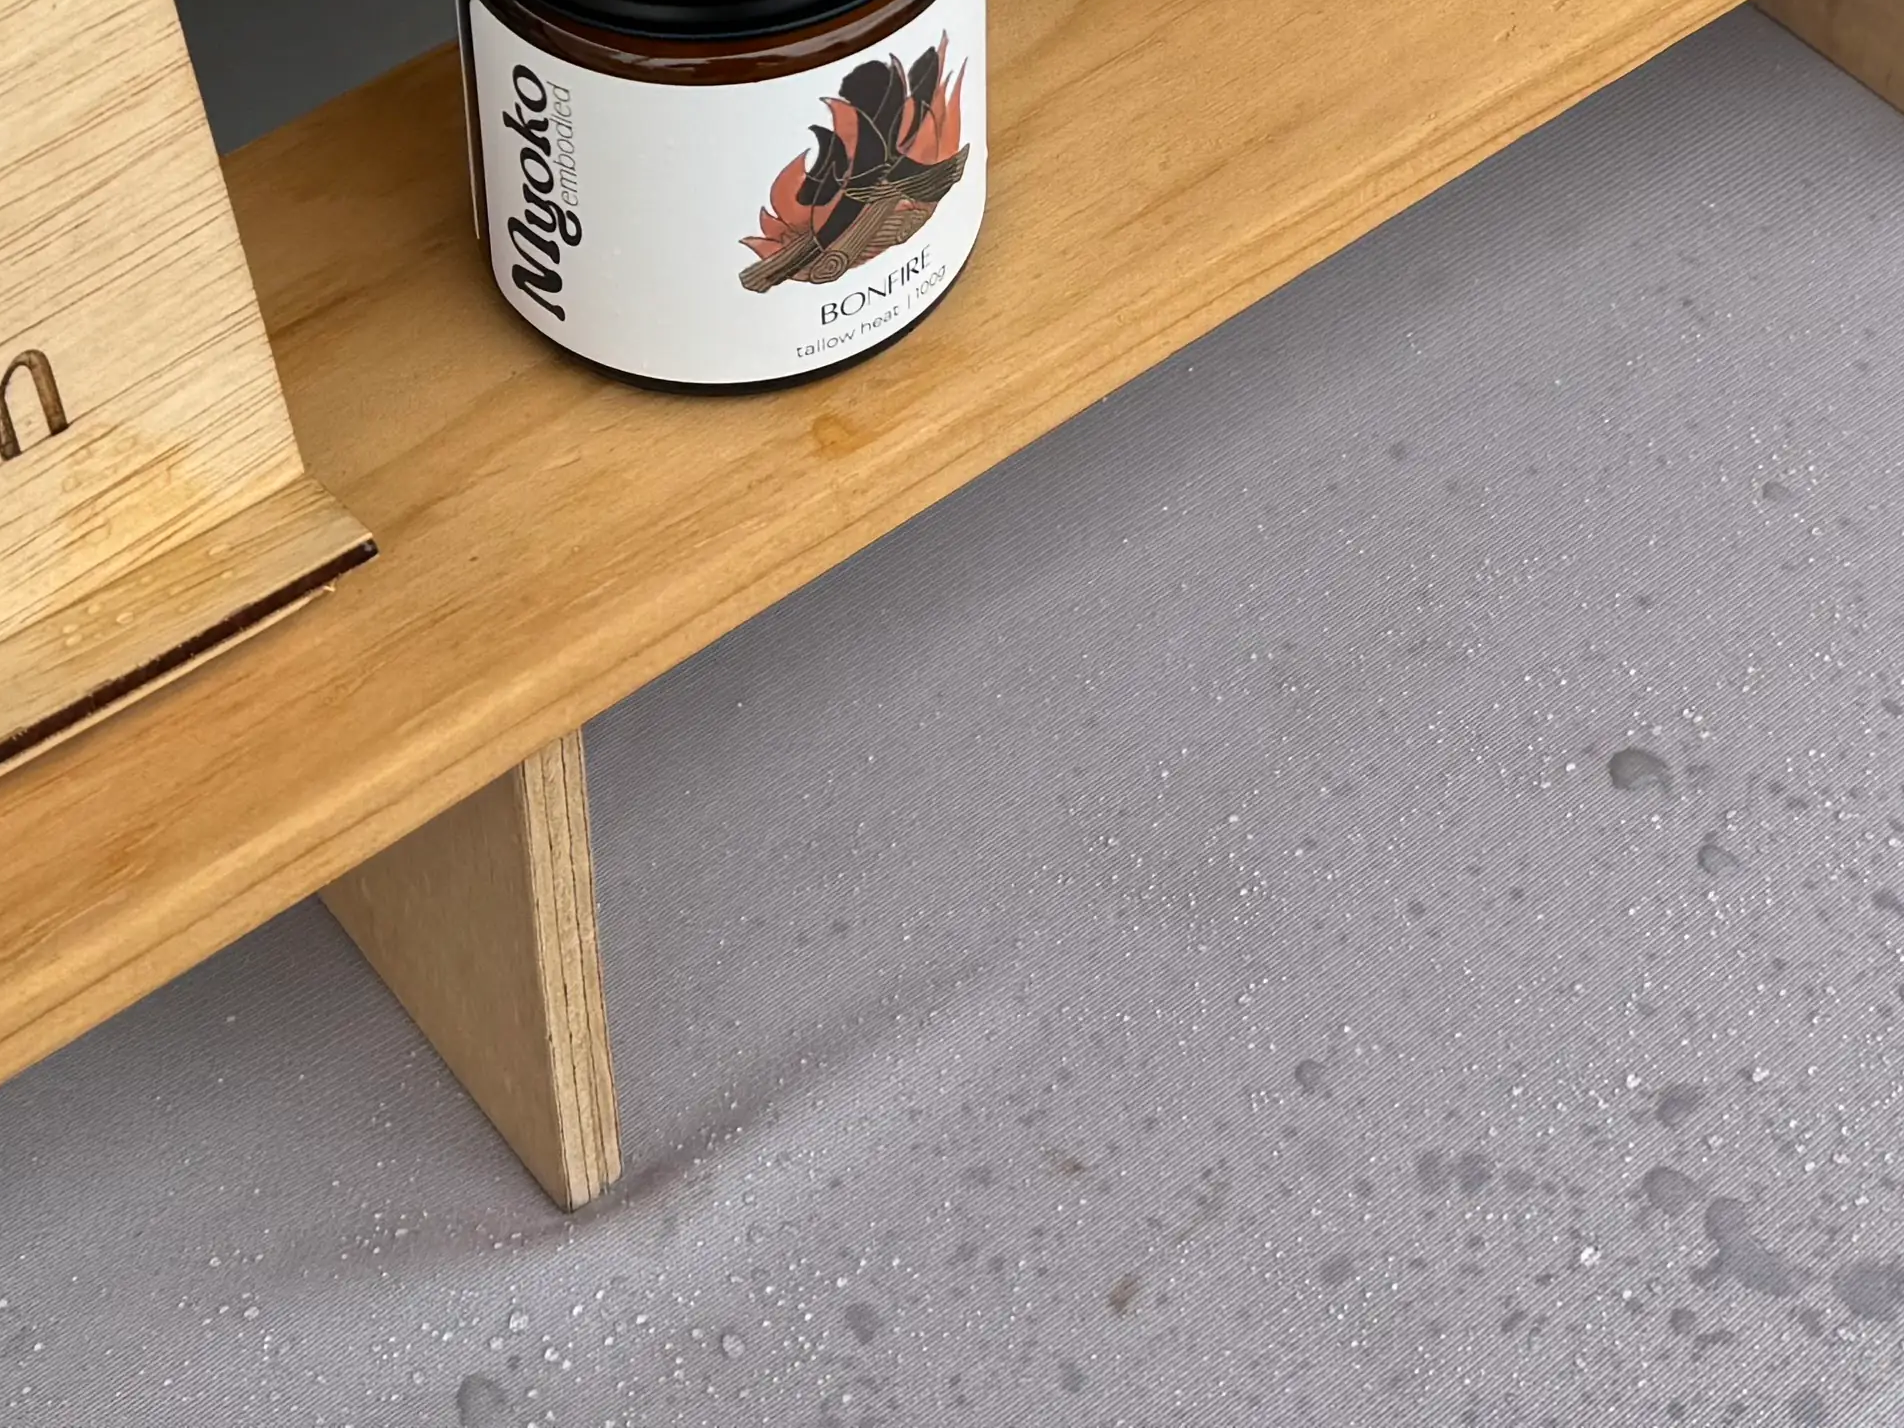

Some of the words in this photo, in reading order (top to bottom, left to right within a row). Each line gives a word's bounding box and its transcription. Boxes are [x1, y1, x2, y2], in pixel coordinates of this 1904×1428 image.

[502, 64, 583, 322] Myoko
[550, 81, 579, 207] embodied
[820, 244, 931, 325] BONFIRE
[796, 328, 856, 358] tallow
